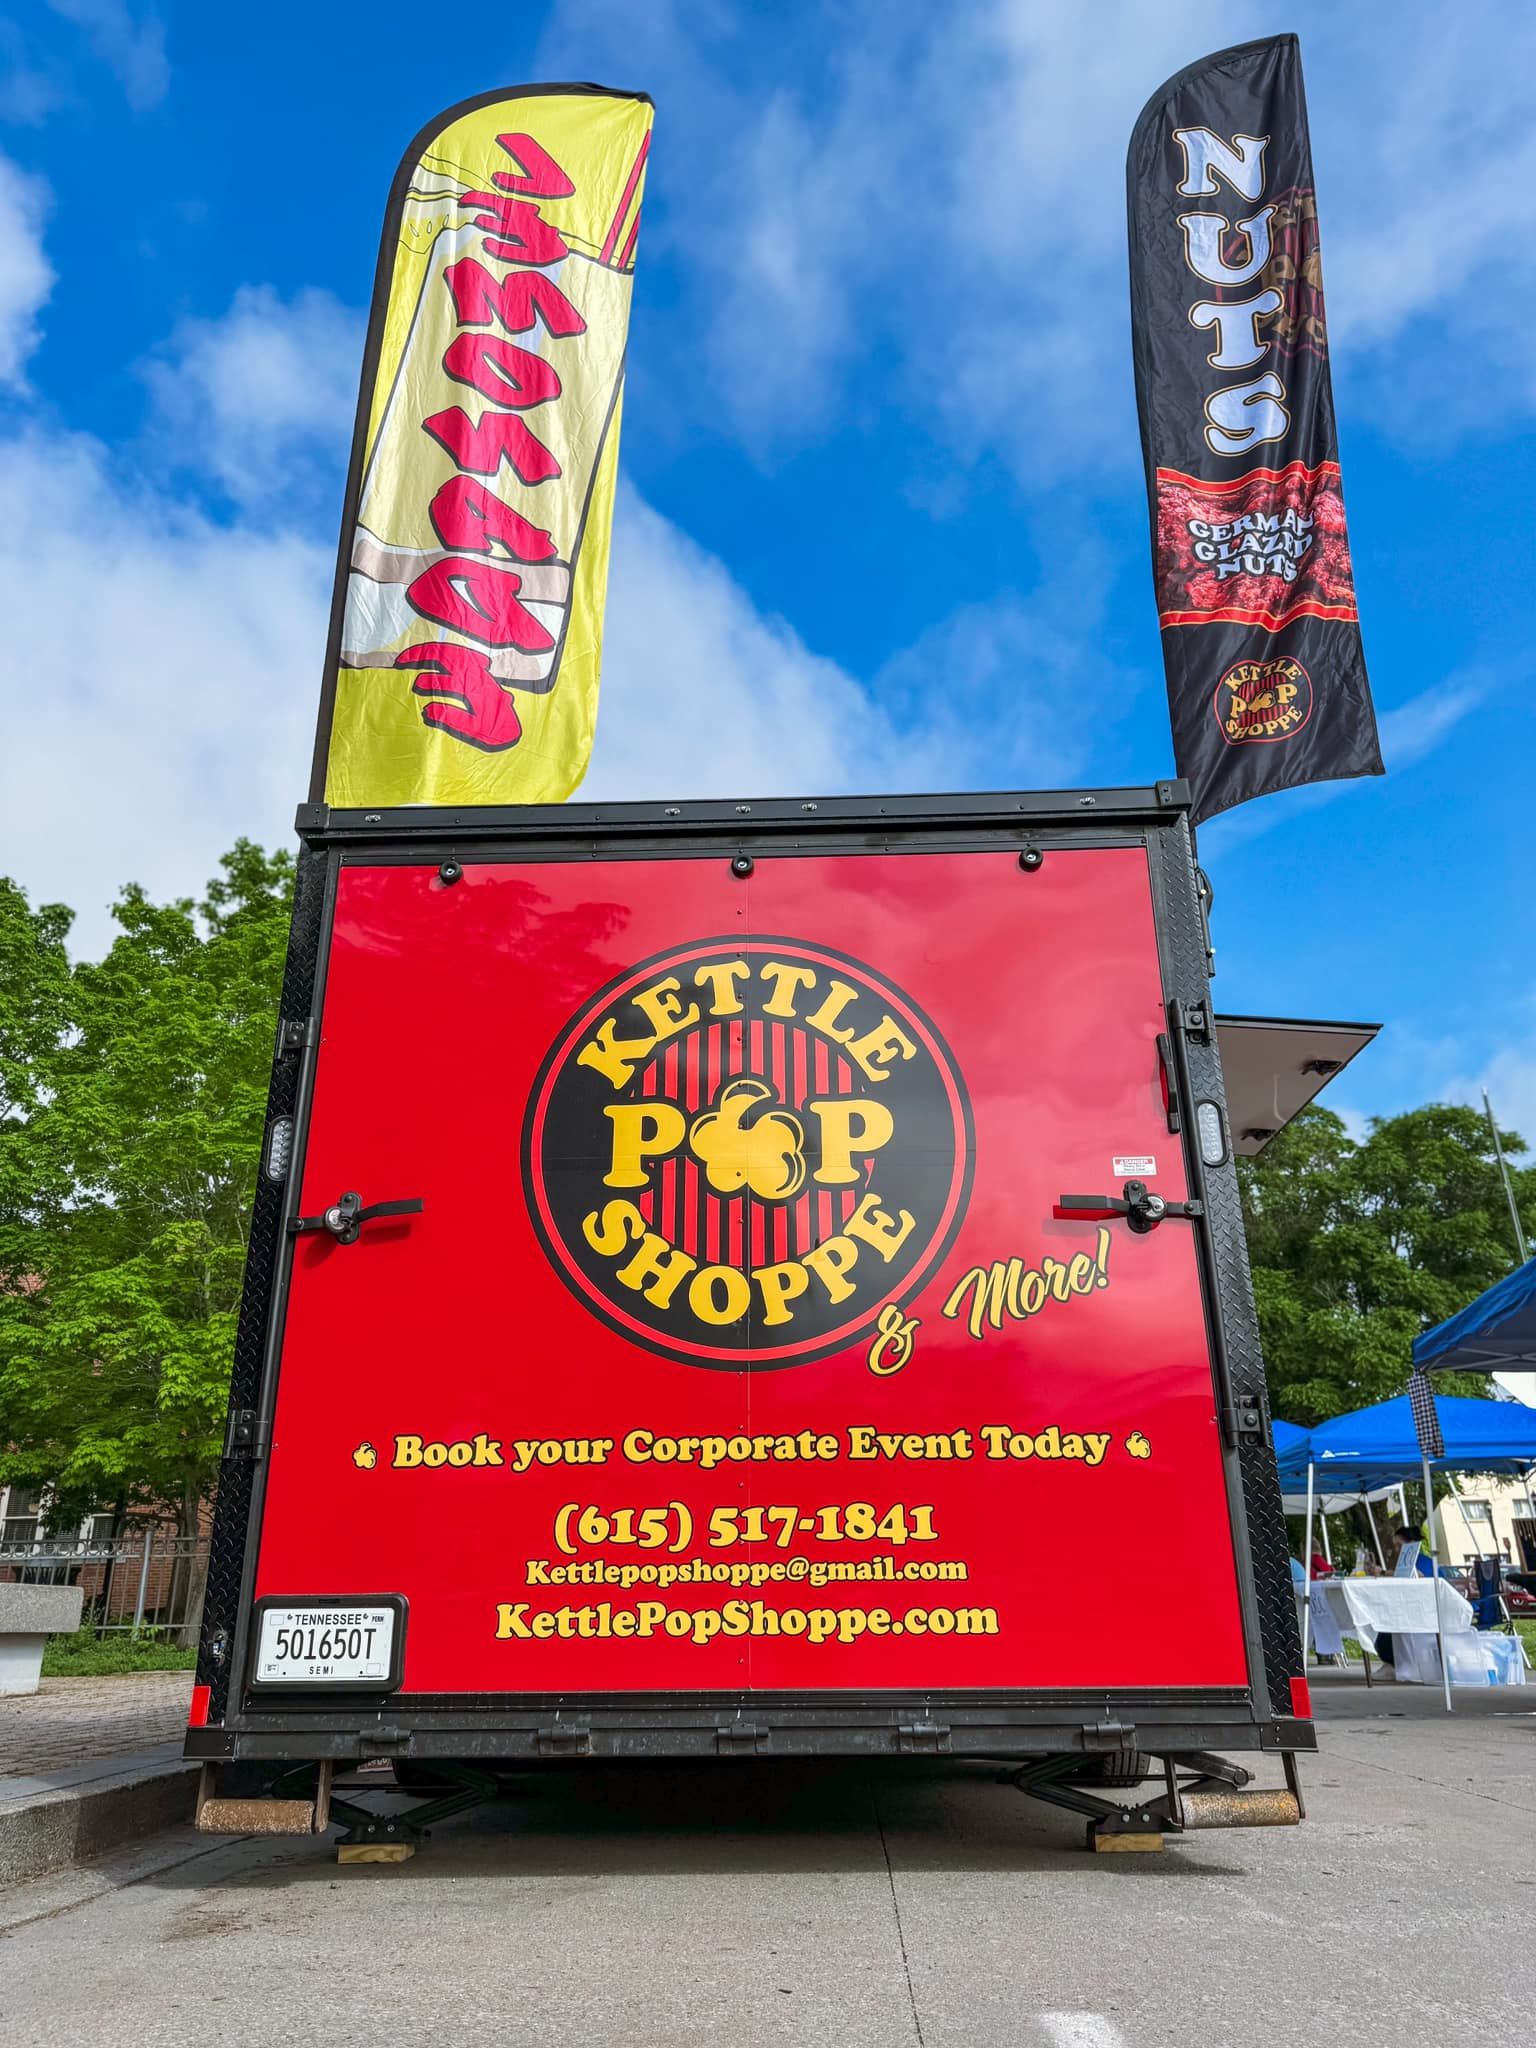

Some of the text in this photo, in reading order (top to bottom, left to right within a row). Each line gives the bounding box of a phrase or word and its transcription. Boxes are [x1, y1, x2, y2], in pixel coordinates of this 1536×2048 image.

[1172, 126, 1291, 456] NUTS
[1194, 531, 1314, 561] GLAZED
[1216, 553, 1299, 583] NUTS
[1225, 660, 1302, 691] KETTLE
[1225, 706, 1303, 739] SHOPPE
[576, 960, 917, 1090] KETTLE
[581, 1193, 917, 1326] SHOPPE
[867, 1227, 1110, 1376] & More!
[392, 1425, 1111, 1472] Book your Corporate Event Today
[554, 1501, 939, 1554] (615) 517-1841
[525, 1556, 968, 1588] Kettlepopshoppe@gmail.com
[296, 1614, 362, 1625] TENNESSEE
[495, 1600, 1000, 1644] KettlePopShoppe.com
[275, 1628, 376, 1660] 501650T
[309, 1666, 334, 1675] SEMI
